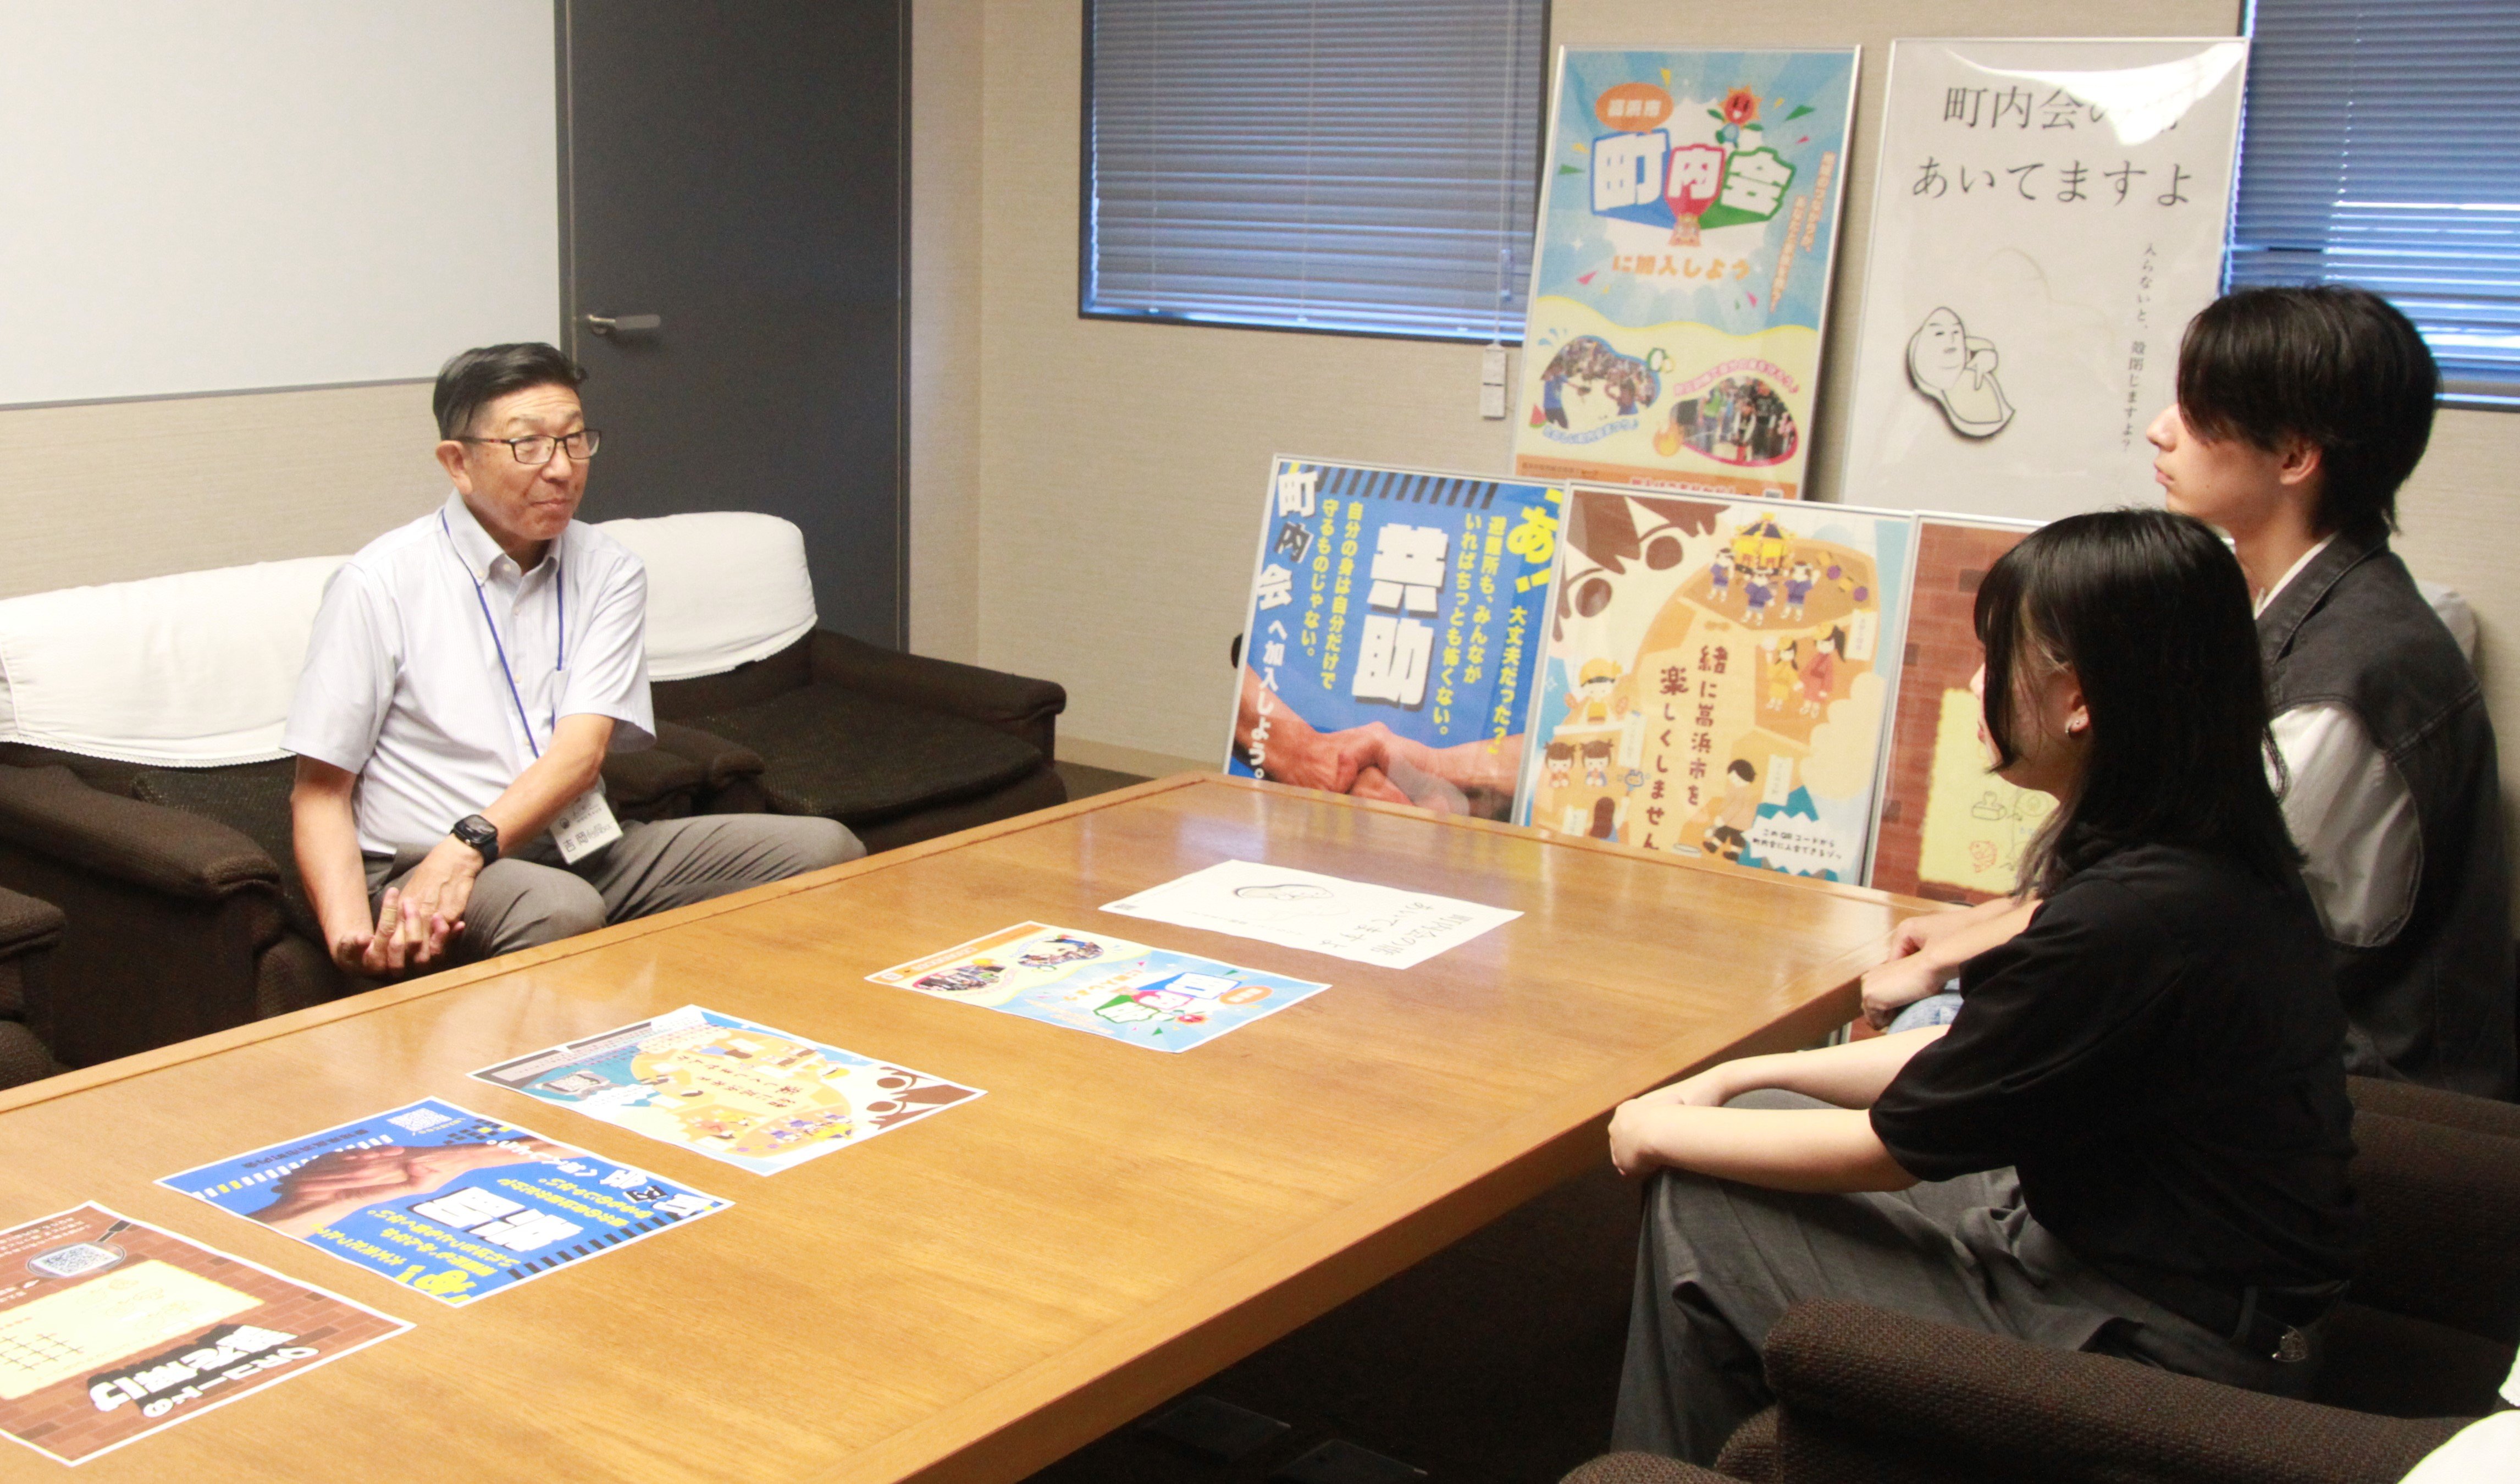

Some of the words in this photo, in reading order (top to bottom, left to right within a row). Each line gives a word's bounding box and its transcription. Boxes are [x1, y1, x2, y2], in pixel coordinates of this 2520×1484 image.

[1592, 130, 1795, 219] 町内会
[1911, 156, 2193, 207] あいてますよ
[1301, 498, 1340, 658] 守るものじゃない。
[1320, 501, 1363, 690] 自分の身は自分だけで
[1351, 522, 1449, 708] 共助
[88, 1324, 299, 1413] 謎を解け
[140, 1346, 319, 1418] QRコードの
